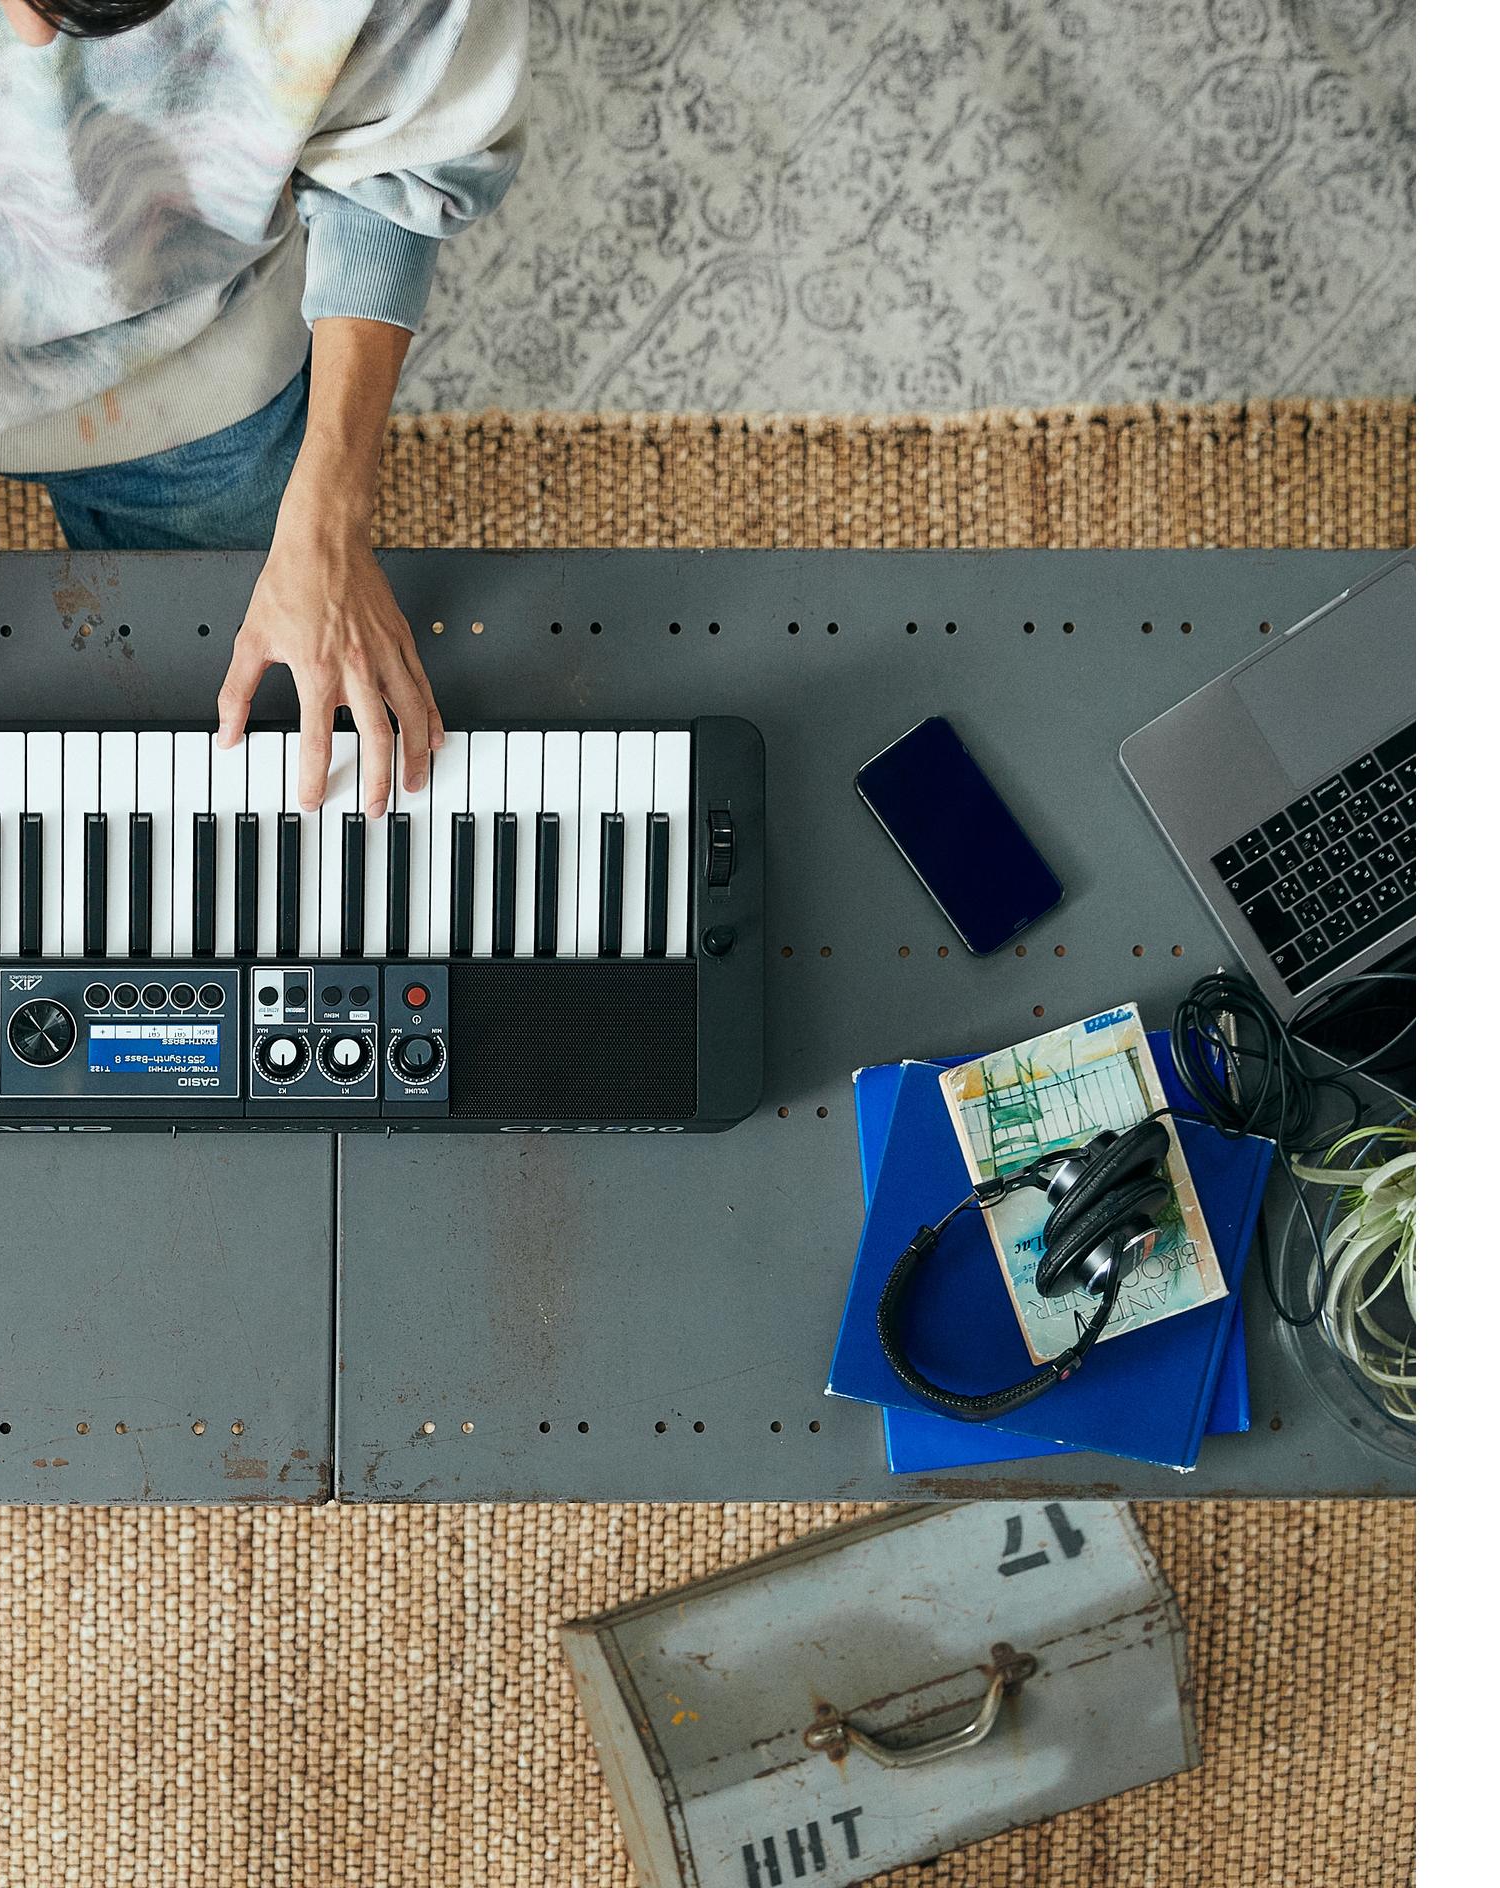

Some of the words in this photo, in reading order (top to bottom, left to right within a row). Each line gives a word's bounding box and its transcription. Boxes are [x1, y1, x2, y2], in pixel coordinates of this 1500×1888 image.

[115, 1055, 121, 1063] 8
[124, 1055, 206, 1064] 255:Synth-Bass
[90, 1065, 110, 1073] T122
[177, 1077, 220, 1087] CASIO
[277, 1087, 287, 1095] K2
[341, 1087, 350, 1095] K1
[404, 1087, 429, 1095] VOLUME
[499, 1125, 685, 1133] CT-S500
[1013, 1235, 1043, 1254] Lac
[998, 1502, 1086, 1577] 17
[742, 1806, 863, 1888] HHT
